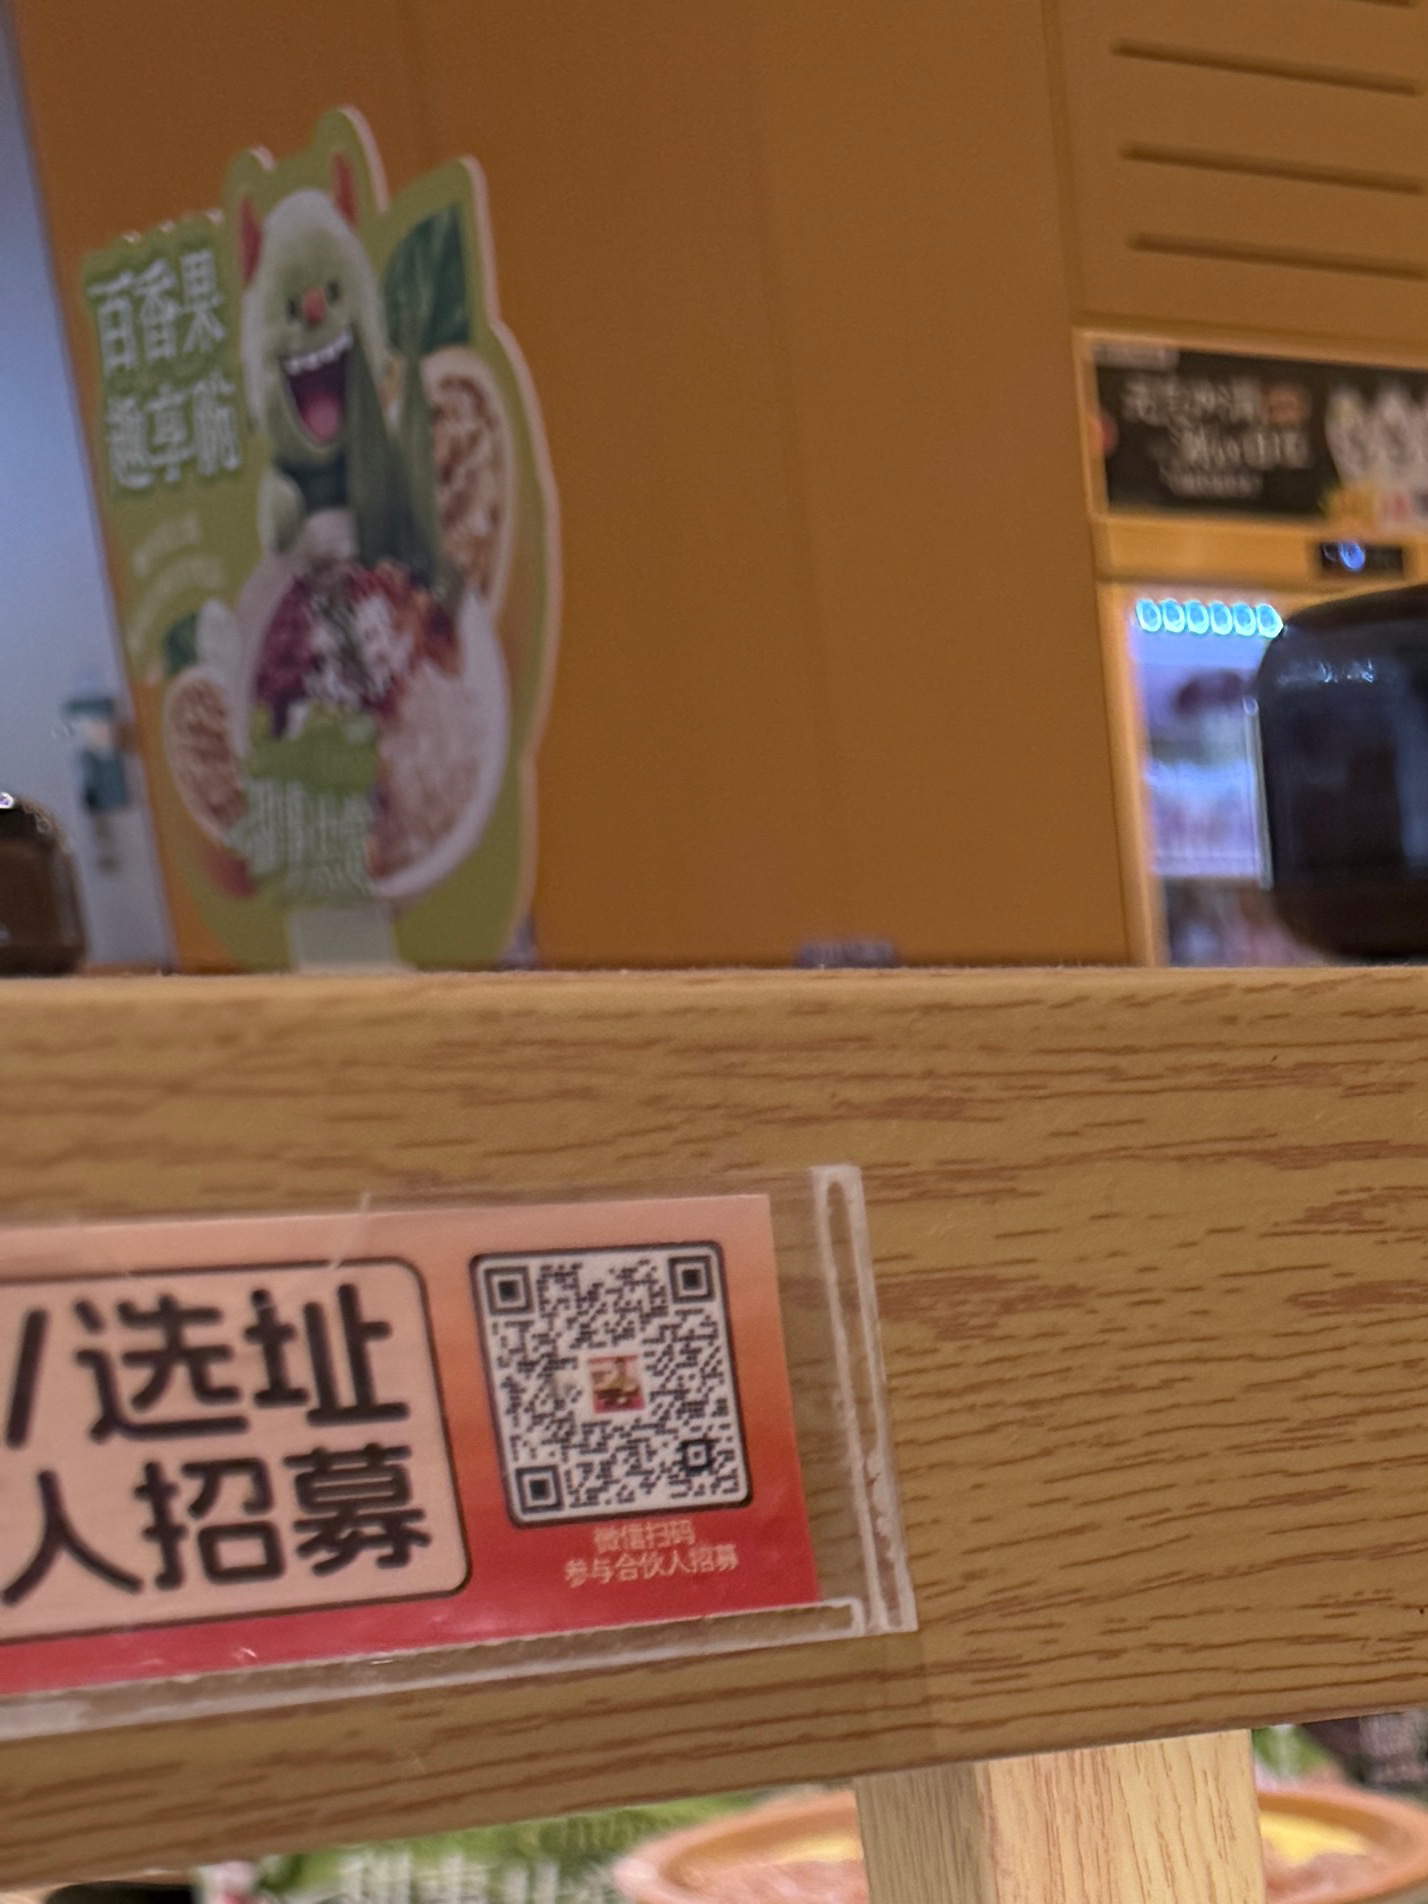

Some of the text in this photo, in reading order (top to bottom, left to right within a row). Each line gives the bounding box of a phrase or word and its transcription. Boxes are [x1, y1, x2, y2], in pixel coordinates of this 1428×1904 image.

[0, 1442, 430, 1602] 人招募
[594, 1519, 696, 1554] 微信扫码
[564, 1543, 739, 1588] 参与合伙人招募
